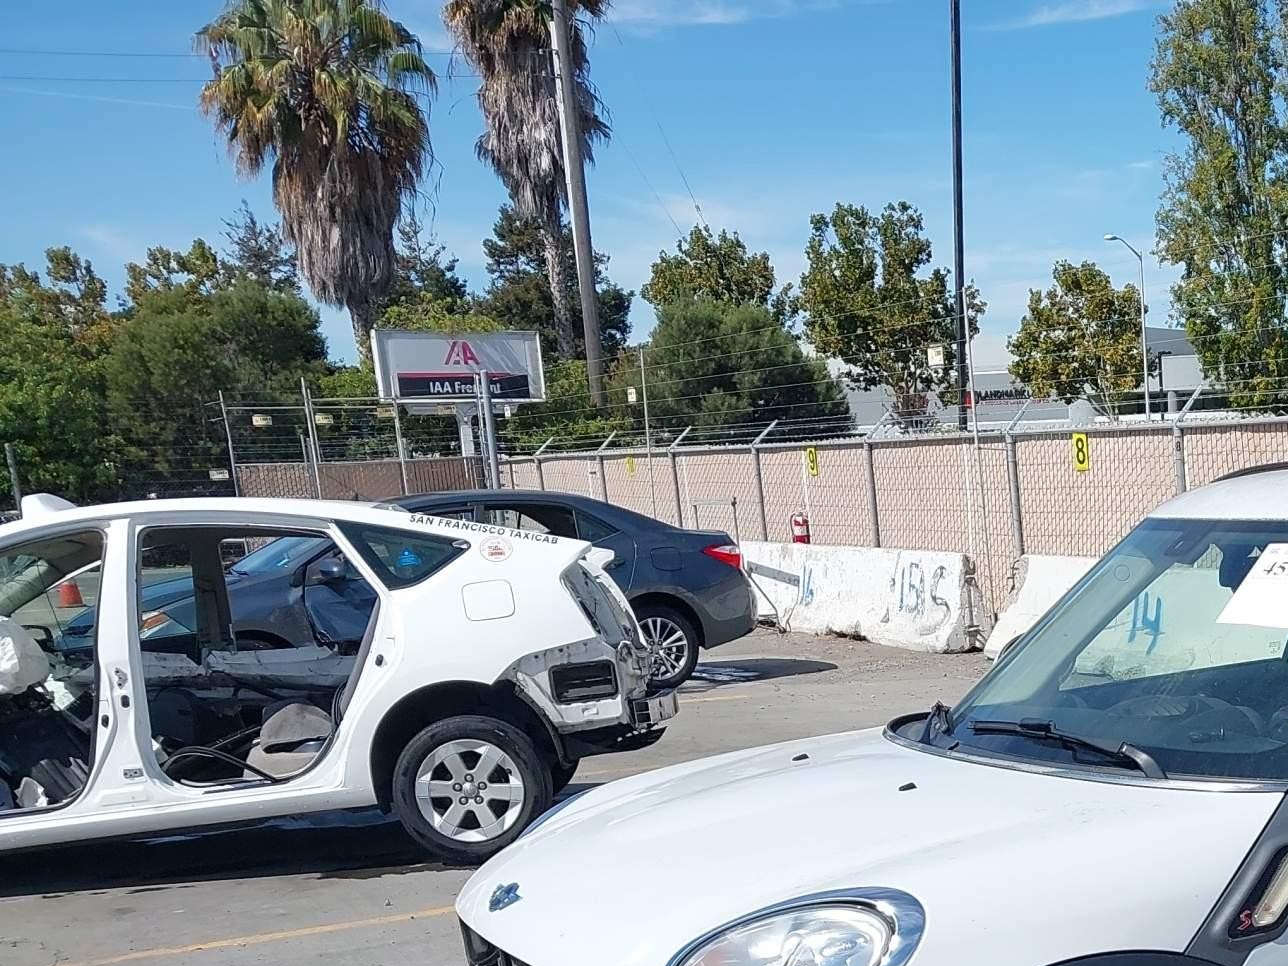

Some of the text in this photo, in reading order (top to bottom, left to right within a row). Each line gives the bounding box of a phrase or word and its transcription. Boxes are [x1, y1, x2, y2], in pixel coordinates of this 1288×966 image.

[430, 381, 501, 394] IAA Frent
[808, 449, 816, 471] 9
[1076, 437, 1086, 465] 8
[409, 514, 559, 545] SAN FRANCISCO TAXICAB
